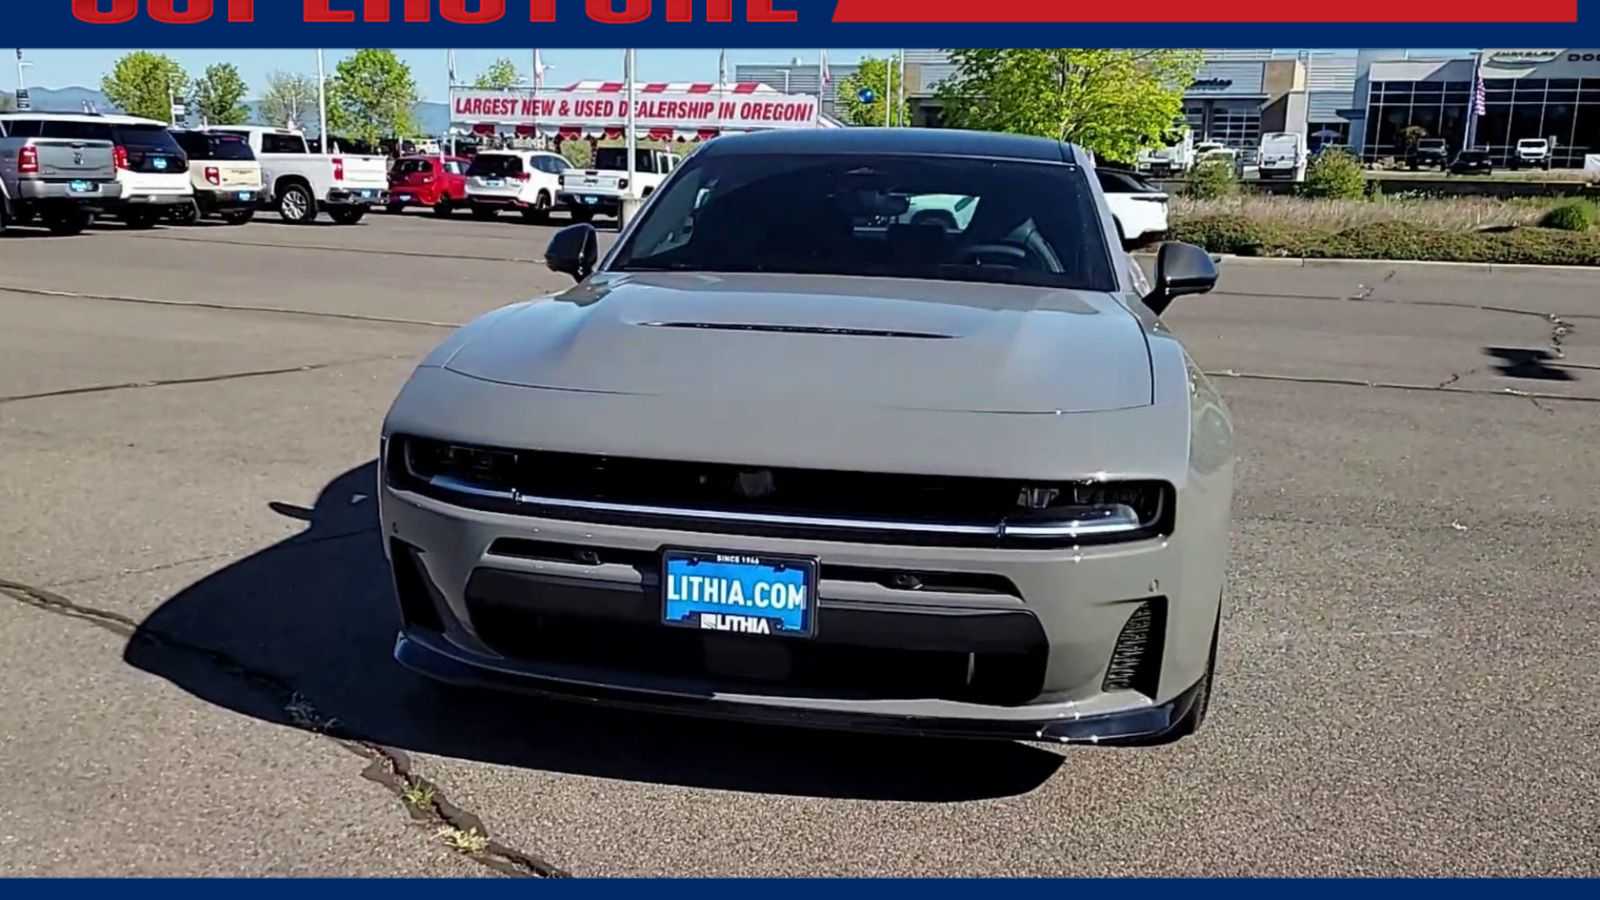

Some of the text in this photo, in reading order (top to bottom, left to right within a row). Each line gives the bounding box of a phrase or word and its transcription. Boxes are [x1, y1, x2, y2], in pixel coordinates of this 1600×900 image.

[1567, 53, 1600, 62] DO
[455, 98, 518, 115] LARGEST
[521, 100, 555, 116] NEW
[558, 101, 570, 116] &
[574, 101, 614, 117] USED
[718, 102, 736, 119] IN
[740, 103, 814, 121] OREGON!
[716, 554, 740, 564] SINCE
[667, 574, 806, 610] LITHIA.COM
[717, 614, 770, 634] LITHIA
